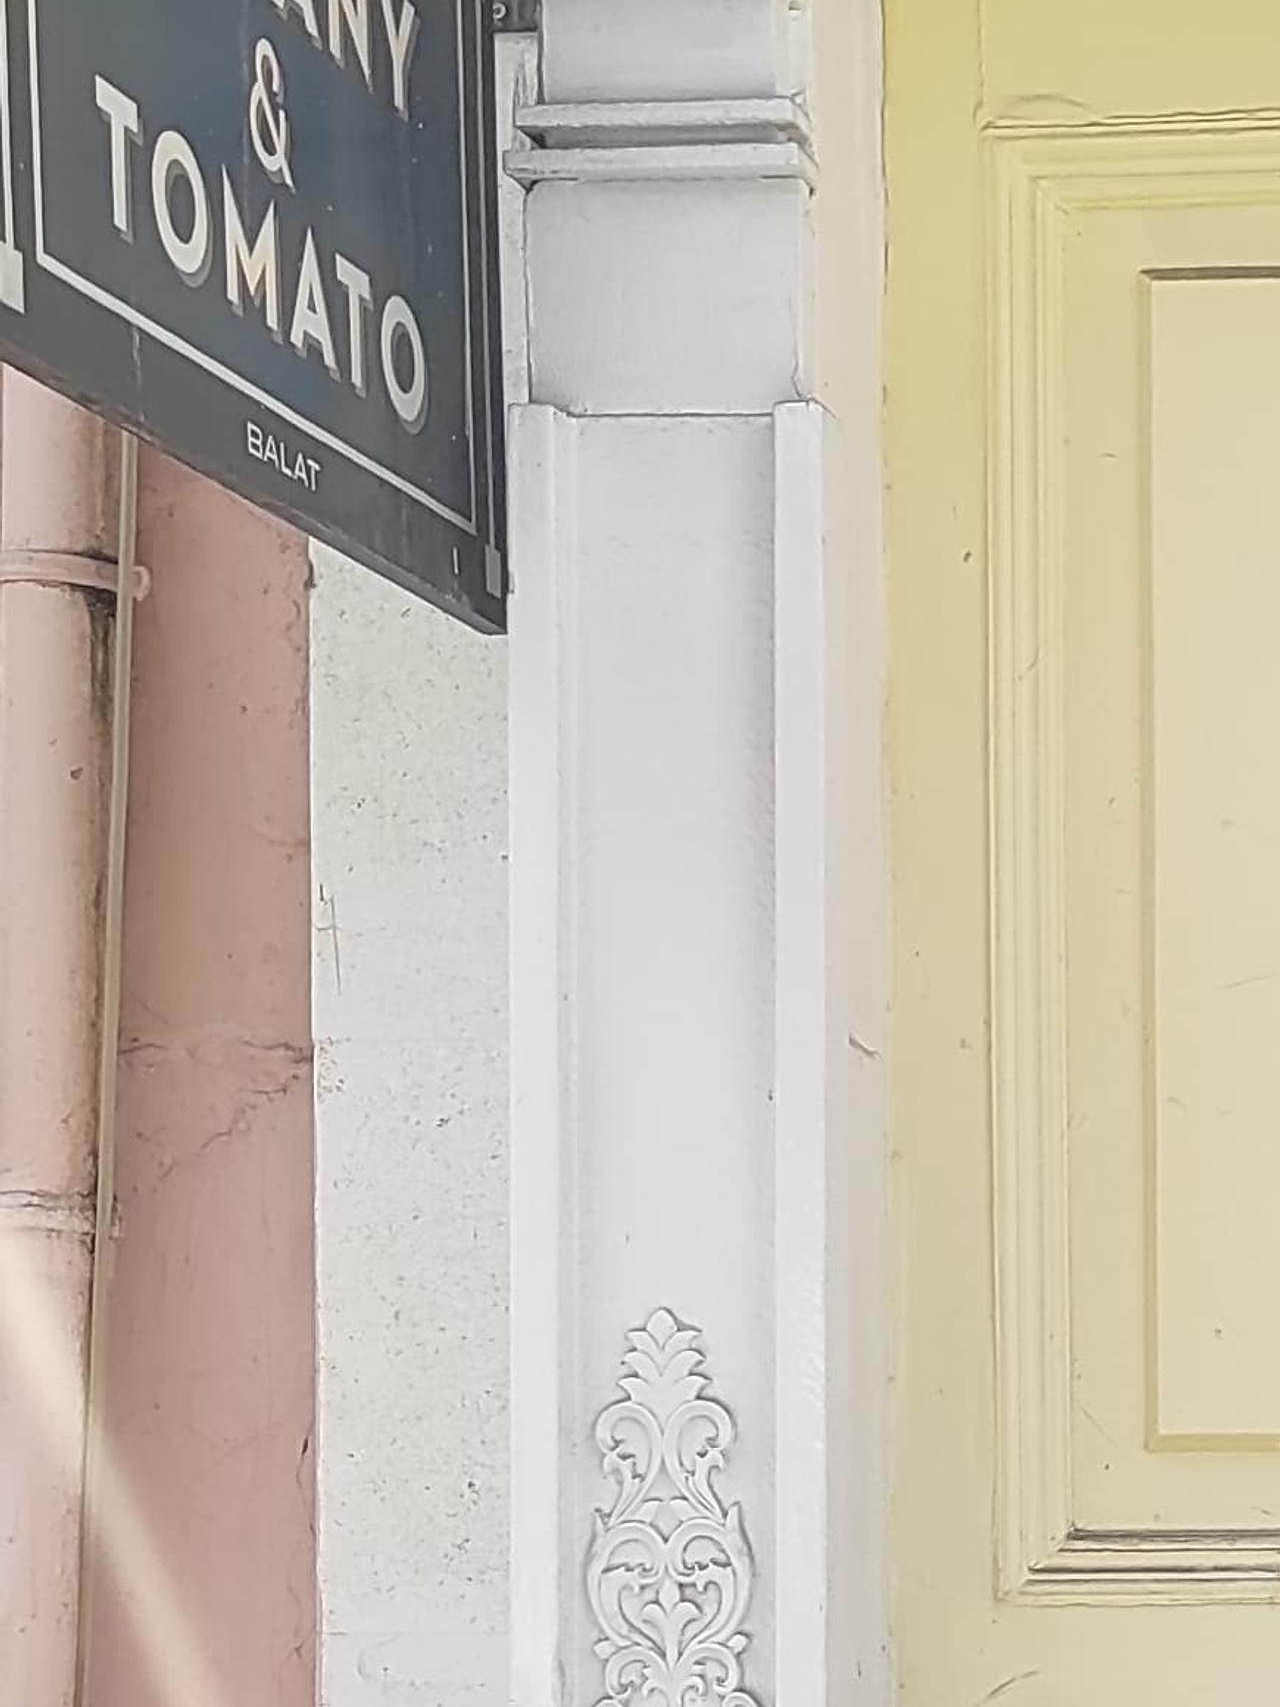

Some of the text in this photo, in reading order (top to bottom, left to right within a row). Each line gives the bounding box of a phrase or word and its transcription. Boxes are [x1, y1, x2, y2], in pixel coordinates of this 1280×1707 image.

[250, 37, 296, 194] &
[95, 73, 428, 424] TOMATO
[246, 420, 321, 491] BALAT
